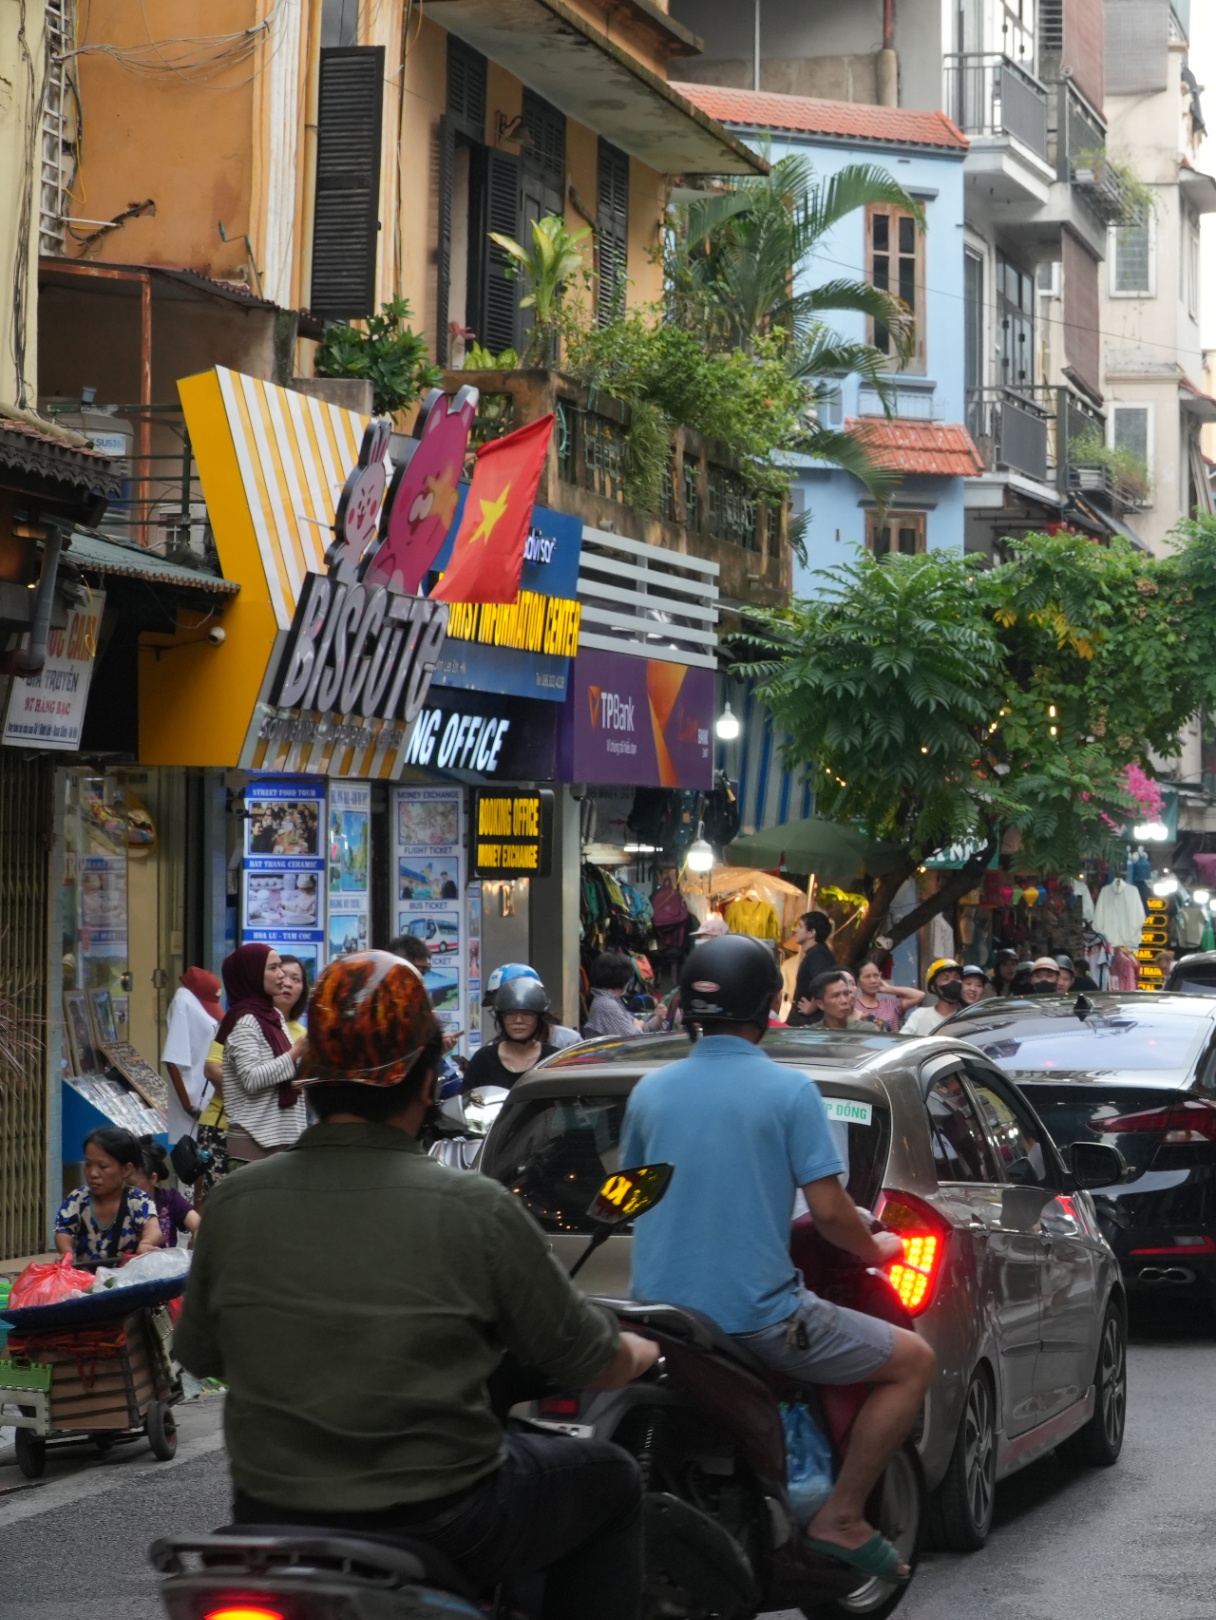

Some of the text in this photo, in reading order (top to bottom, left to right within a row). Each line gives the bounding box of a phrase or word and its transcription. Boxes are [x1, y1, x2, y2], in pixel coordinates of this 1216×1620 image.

[523, 527, 555, 564] advisor
[544, 596, 582, 657] CENTER
[24, 697, 35, 712] 97
[600, 692, 635, 732] TPBank
[404, 708, 442, 766] NG
[437, 712, 511, 772] OFFICE
[252, 789, 316, 797] STREET FOOD TOUR
[397, 791, 459, 799] MONEY EXCHANGE
[478, 798, 539, 836] BOOKING OFFICE
[287, 861, 318, 869] CERAMIC
[477, 843, 539, 868] MONEY EXCHANGE
[409, 902, 448, 910] BUS TICKET
[431, 957, 452, 965] ICKET
